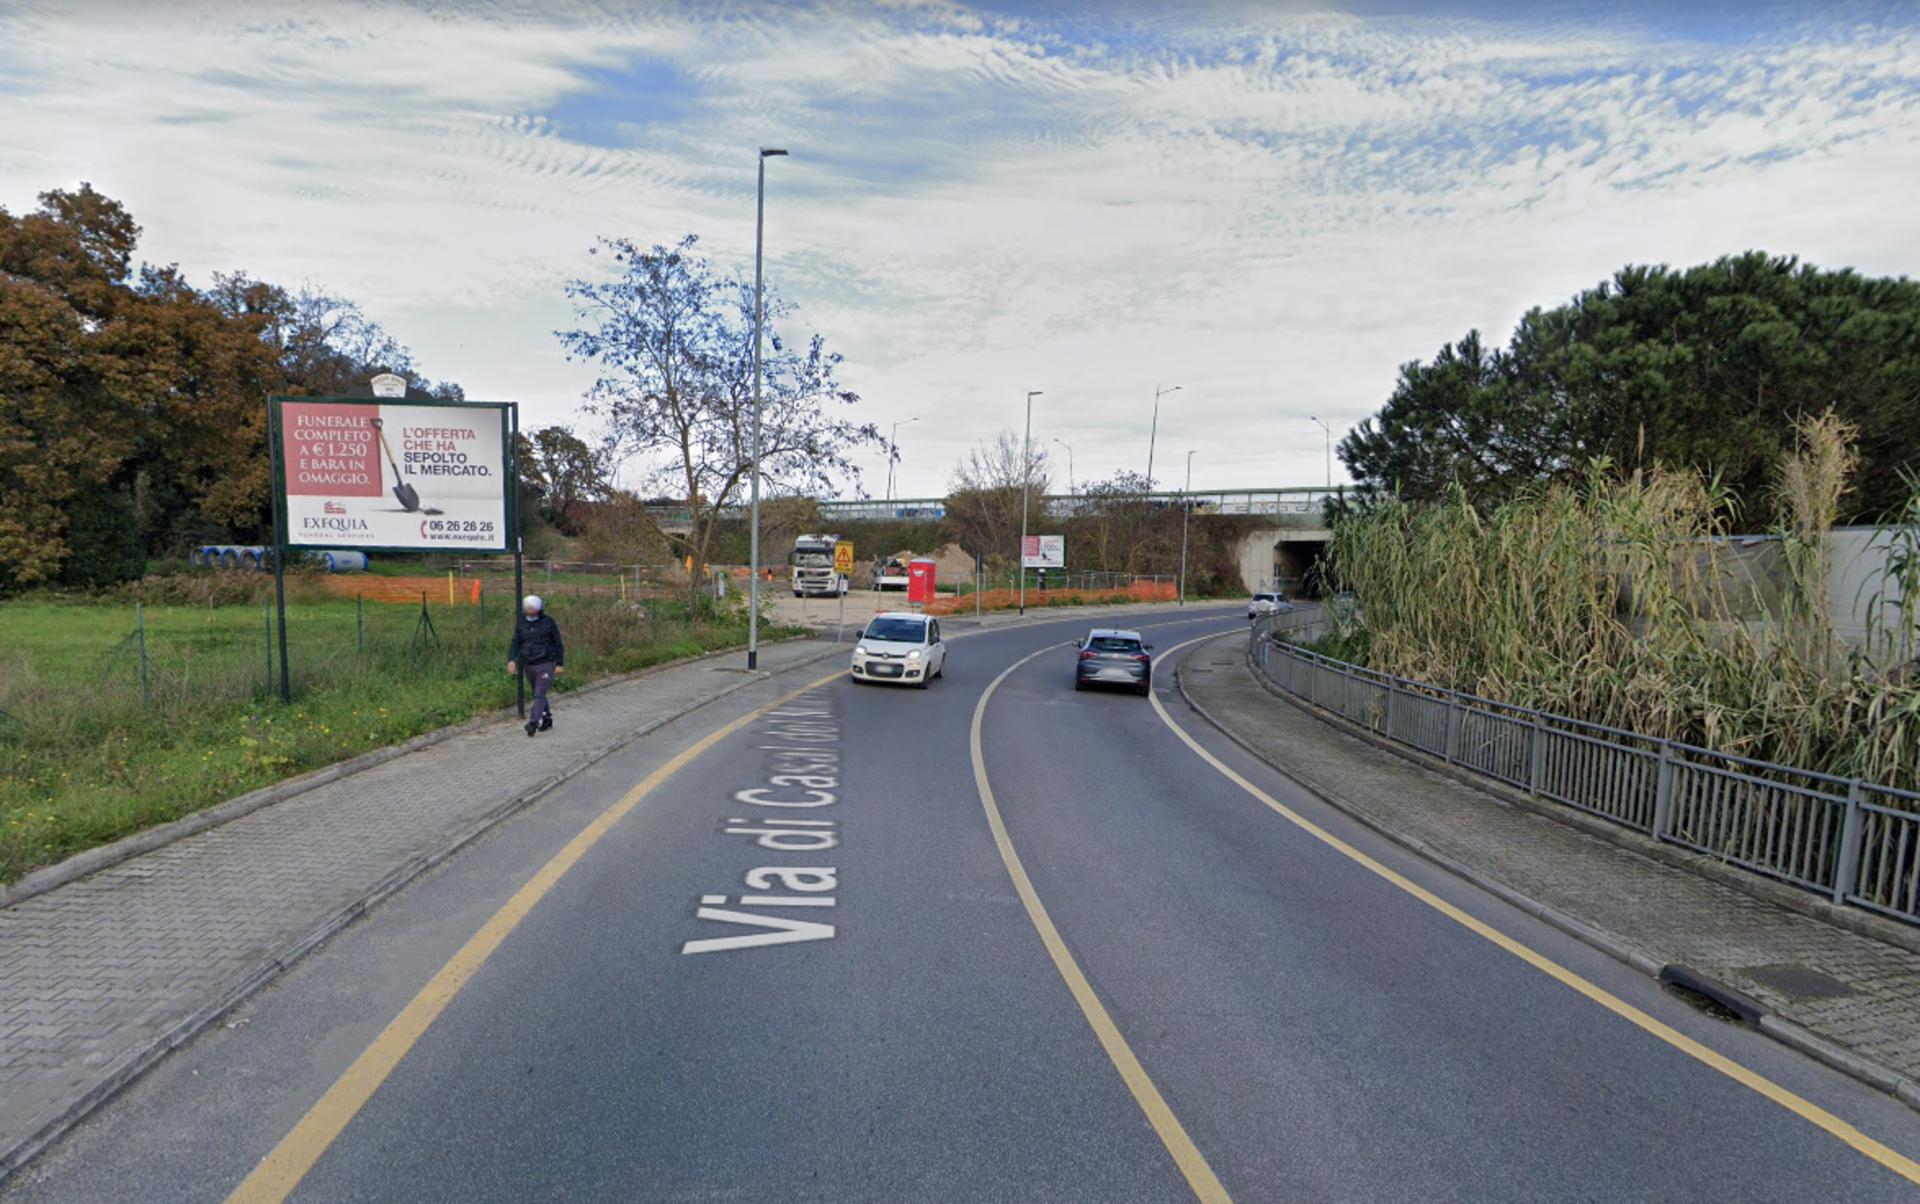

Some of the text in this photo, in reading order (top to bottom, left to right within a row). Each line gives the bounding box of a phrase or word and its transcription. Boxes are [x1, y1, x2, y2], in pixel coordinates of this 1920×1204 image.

[298, 416, 367, 428] FUNERALE
[294, 429, 372, 442] COMPLETO
[402, 427, 476, 440] L'OFFERTA
[300, 445, 309, 456] A
[403, 440, 456, 451] CHE HA
[403, 452, 467, 464] SEPOLTO
[300, 459, 366, 471] E BARA IN
[404, 464, 492, 477] IL MERCATO.
[298, 472, 371, 485] OMAGGIO.
[303, 517, 369, 531] EXEQUIA
[429, 520, 495, 533] 06 26 26 26
